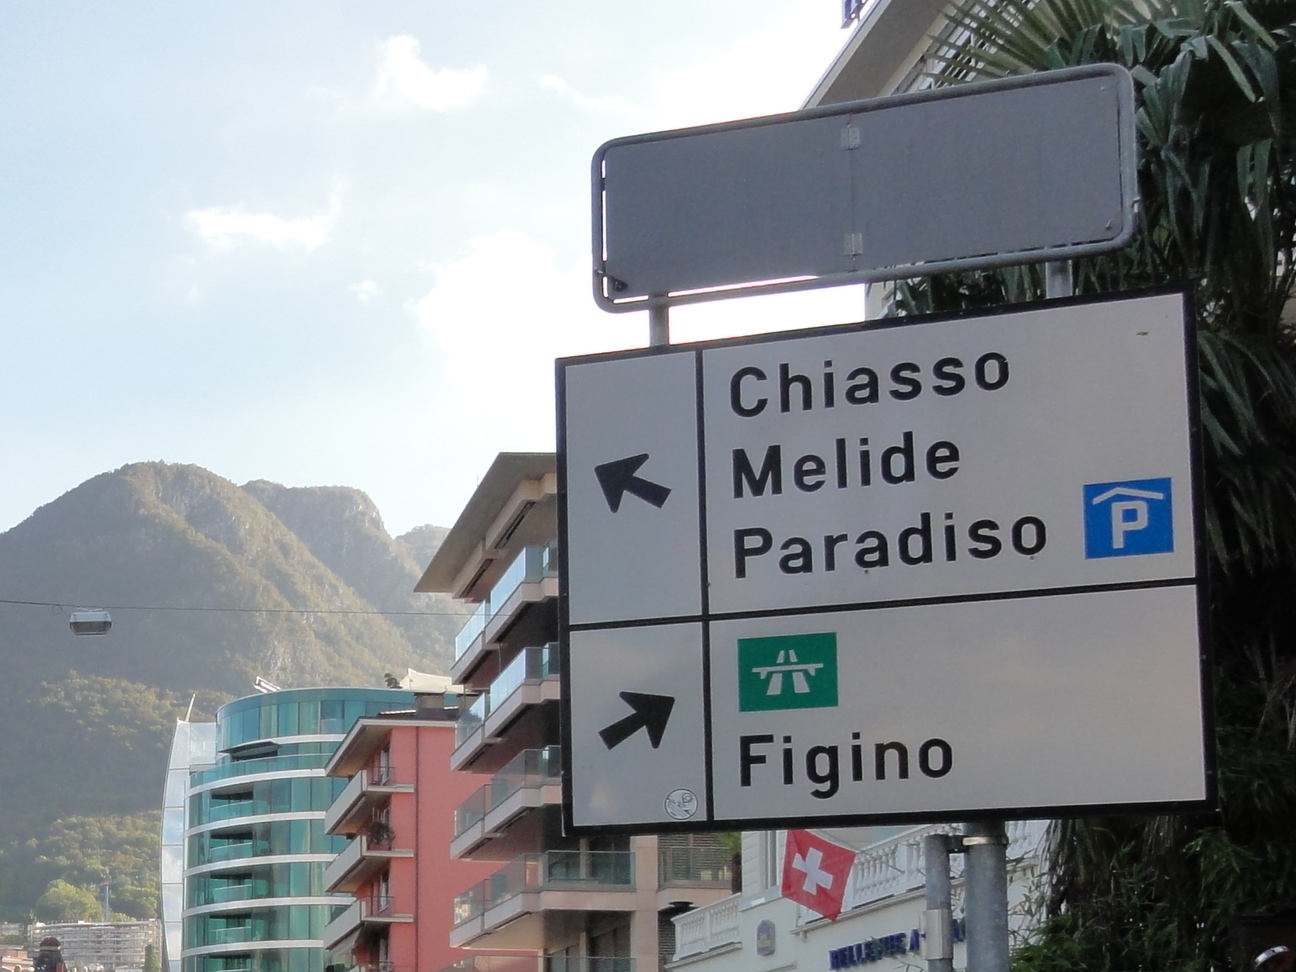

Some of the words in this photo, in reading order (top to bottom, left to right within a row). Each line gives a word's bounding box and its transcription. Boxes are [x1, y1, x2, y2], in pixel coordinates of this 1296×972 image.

[730, 352, 1009, 417] Chiasso
[732, 431, 959, 498] Melide
[734, 512, 1046, 578] Paradiso
[740, 733, 953, 799] Figino
